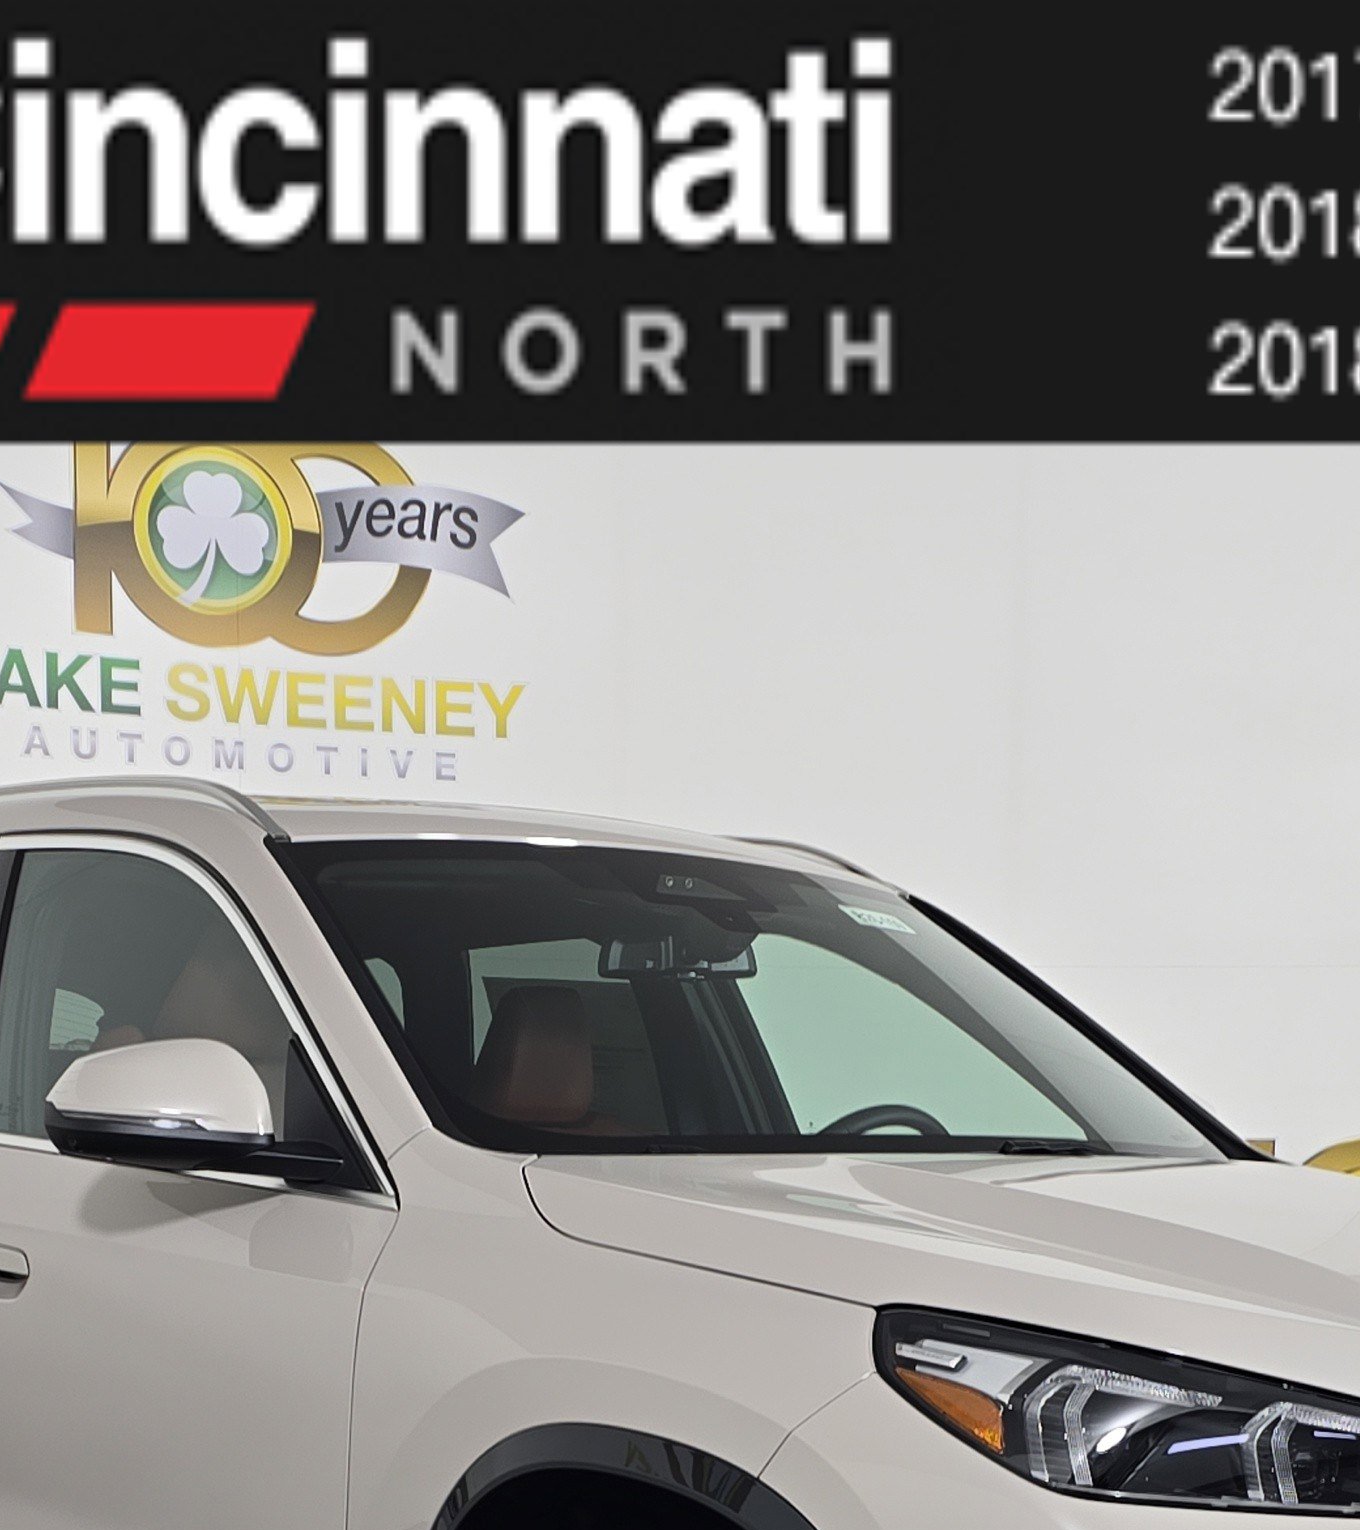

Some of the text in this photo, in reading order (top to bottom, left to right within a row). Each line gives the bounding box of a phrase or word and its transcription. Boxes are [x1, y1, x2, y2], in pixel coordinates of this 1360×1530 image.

[334, 499, 479, 554] years
[165, 663, 526, 739] SWEENEY
[22, 725, 457, 782] AUTOMOTIVE
